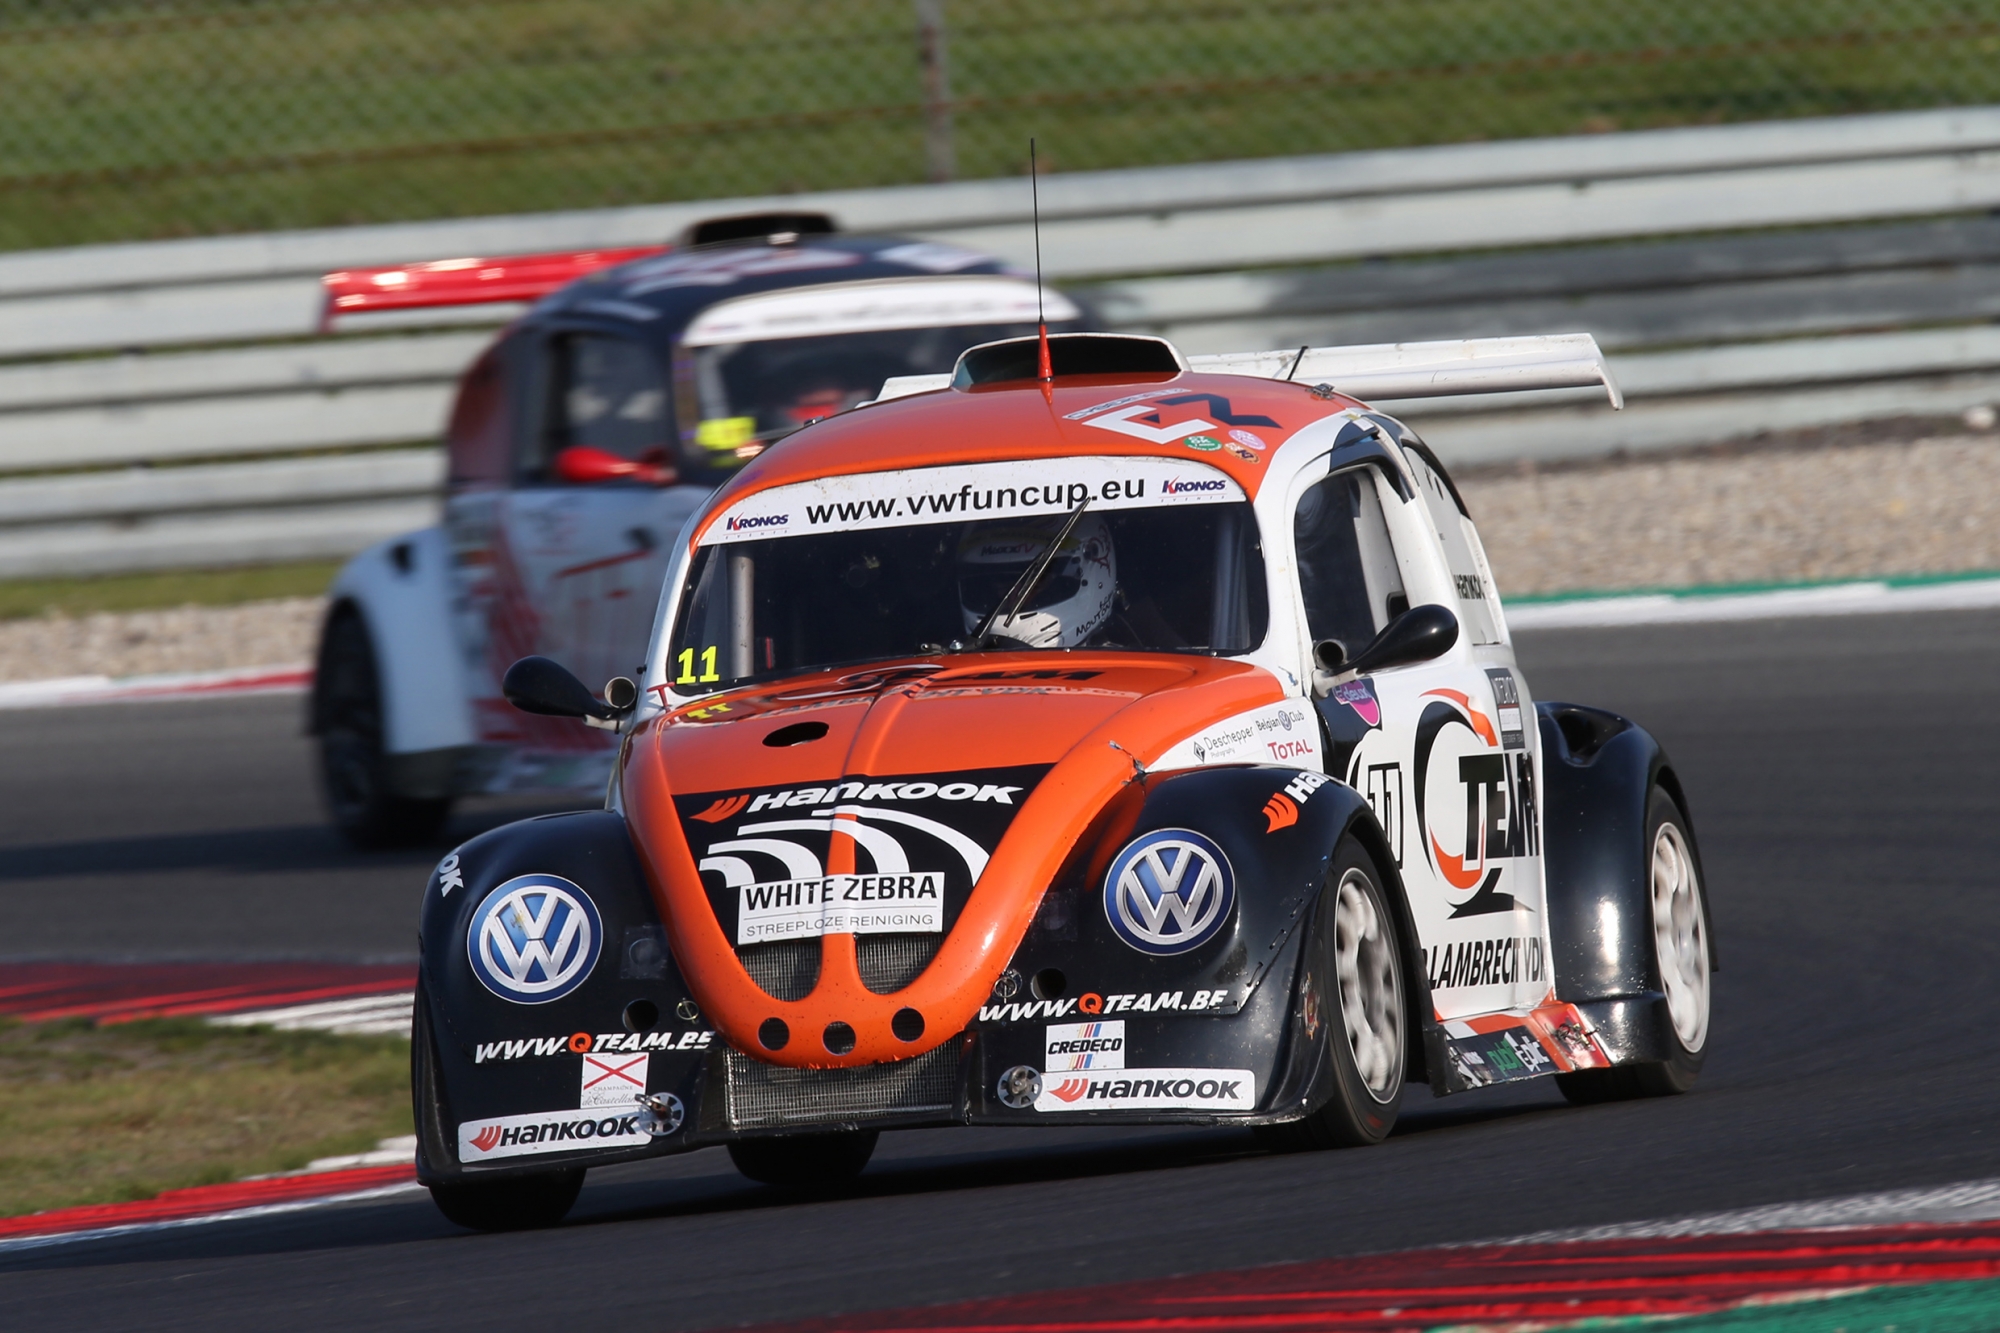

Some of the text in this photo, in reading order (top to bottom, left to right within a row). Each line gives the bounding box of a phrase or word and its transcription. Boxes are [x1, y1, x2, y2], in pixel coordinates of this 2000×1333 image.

[1161, 475, 1226, 494] KRONOS
[806, 476, 1144, 525] www.vwfuncup.eu
[726, 512, 789, 531] KRONOS
[675, 645, 720, 685] 11
[1255, 717, 1280, 732] Belgian
[1289, 710, 1305, 723] Club
[1203, 726, 1254, 751] Deschepper
[1267, 739, 1313, 760] TOTAL
[745, 875, 938, 911] WHITE ZEBRA
[746, 913, 934, 938] STREEPLOZE REINIGING
[978, 989, 1229, 1022] WWW.QTEAM.BE
[475, 1031, 714, 1064] WWW.QTEAM.BE
[1047, 1037, 1122, 1055] CREDECO
